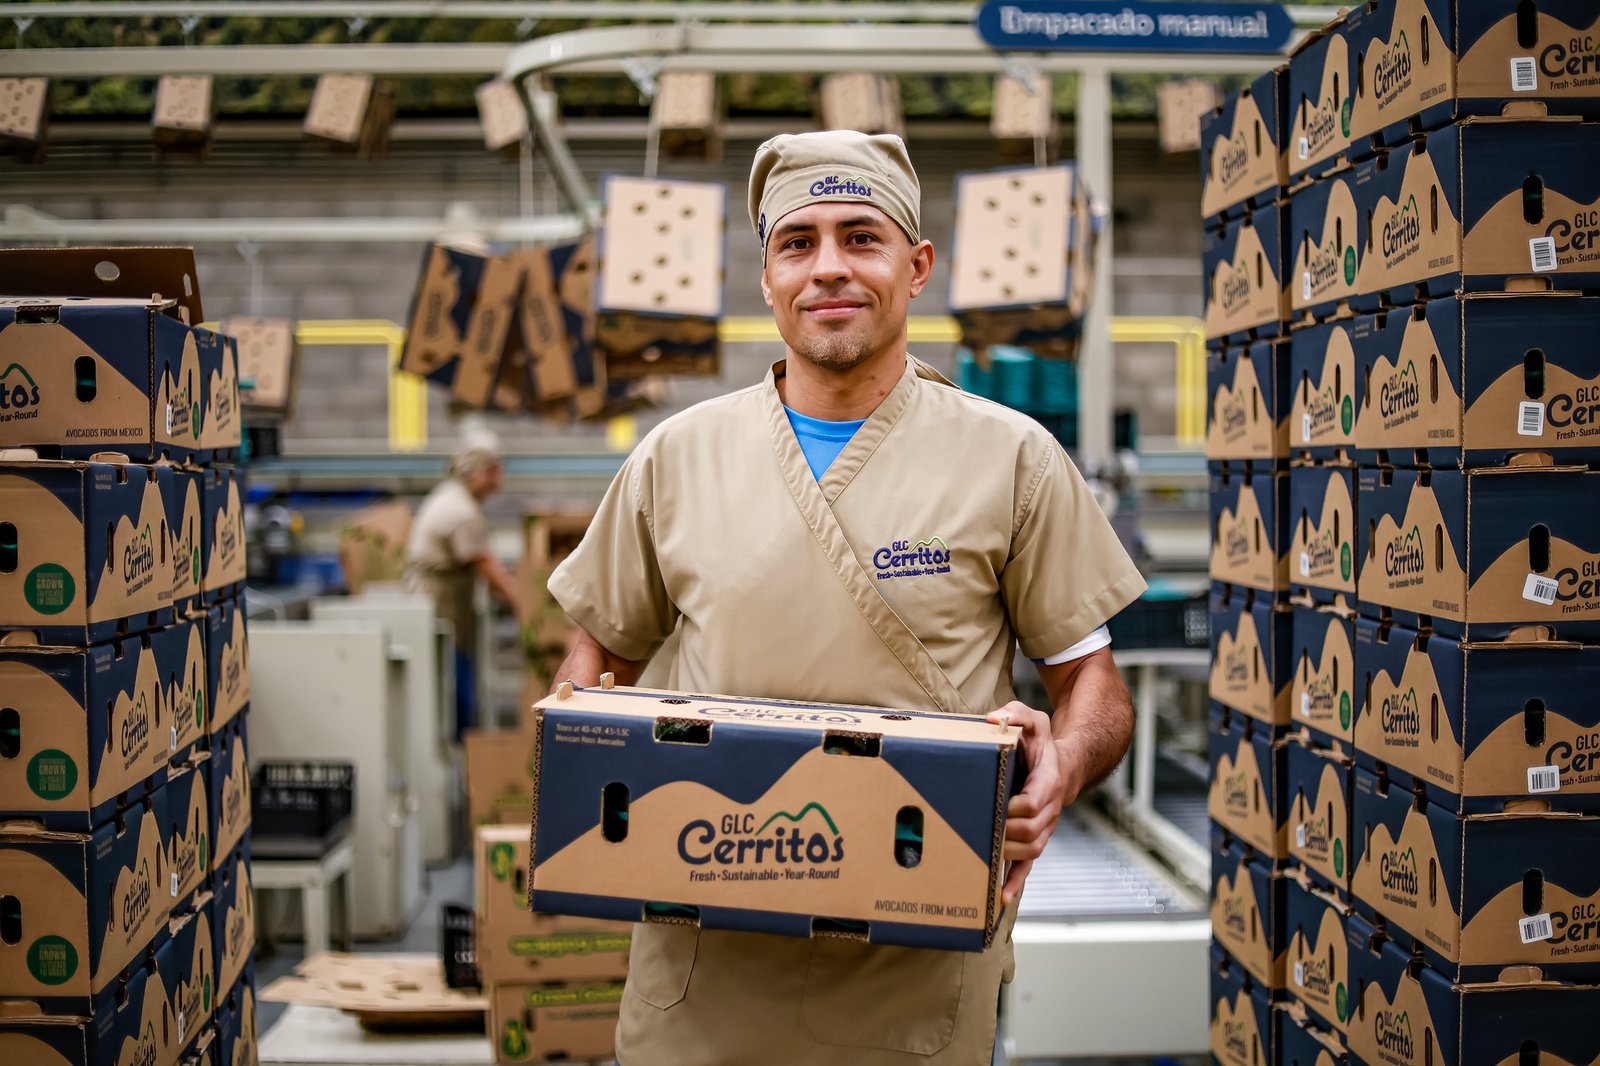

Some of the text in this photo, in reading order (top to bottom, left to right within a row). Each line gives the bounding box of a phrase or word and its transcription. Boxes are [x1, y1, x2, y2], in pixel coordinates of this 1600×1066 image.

[1000, 6, 1269, 39] Empacado manual
[1570, 36, 1593, 54] GLC
[1374, 52, 1411, 99] Cerritos
[1551, 80, 1569, 90] Fresh
[809, 180, 872, 197] Cerritos
[825, 176, 839, 185] GLC
[1575, 211, 1598, 229] GLC
[1382, 216, 1420, 258] Cerritos
[1380, 381, 1419, 418] Cerritos
[1576, 386, 1600, 403] GLC
[65, 427, 143, 438] AVOCADOS FROM MEXICO
[1556, 430, 1575, 440] Fresh
[892, 540, 909, 552] GLC
[124, 543, 154, 584] Cerritos
[873, 547, 951, 570] Cerritos
[1385, 545, 1424, 577] Cerritos
[1562, 603, 1581, 614] Fresh
[698, 707, 862, 724] Cerritos
[1382, 705, 1420, 735] Cerritos
[1576, 733, 1599, 751] GLC
[1560, 777, 1574, 787] resh
[721, 813, 755, 835] GLC
[677, 819, 844, 865] Cerritos
[690, 867, 840, 882] Fresh Sustainable Year-Round
[1381, 853, 1418, 896] Cerritos
[875, 899, 978, 919] AVOCADOS FROM MEXICO
[1572, 903, 1595, 921] GLC
[1551, 946, 1570, 957] Fresh
[1375, 1011, 1413, 1060] Cerritos
